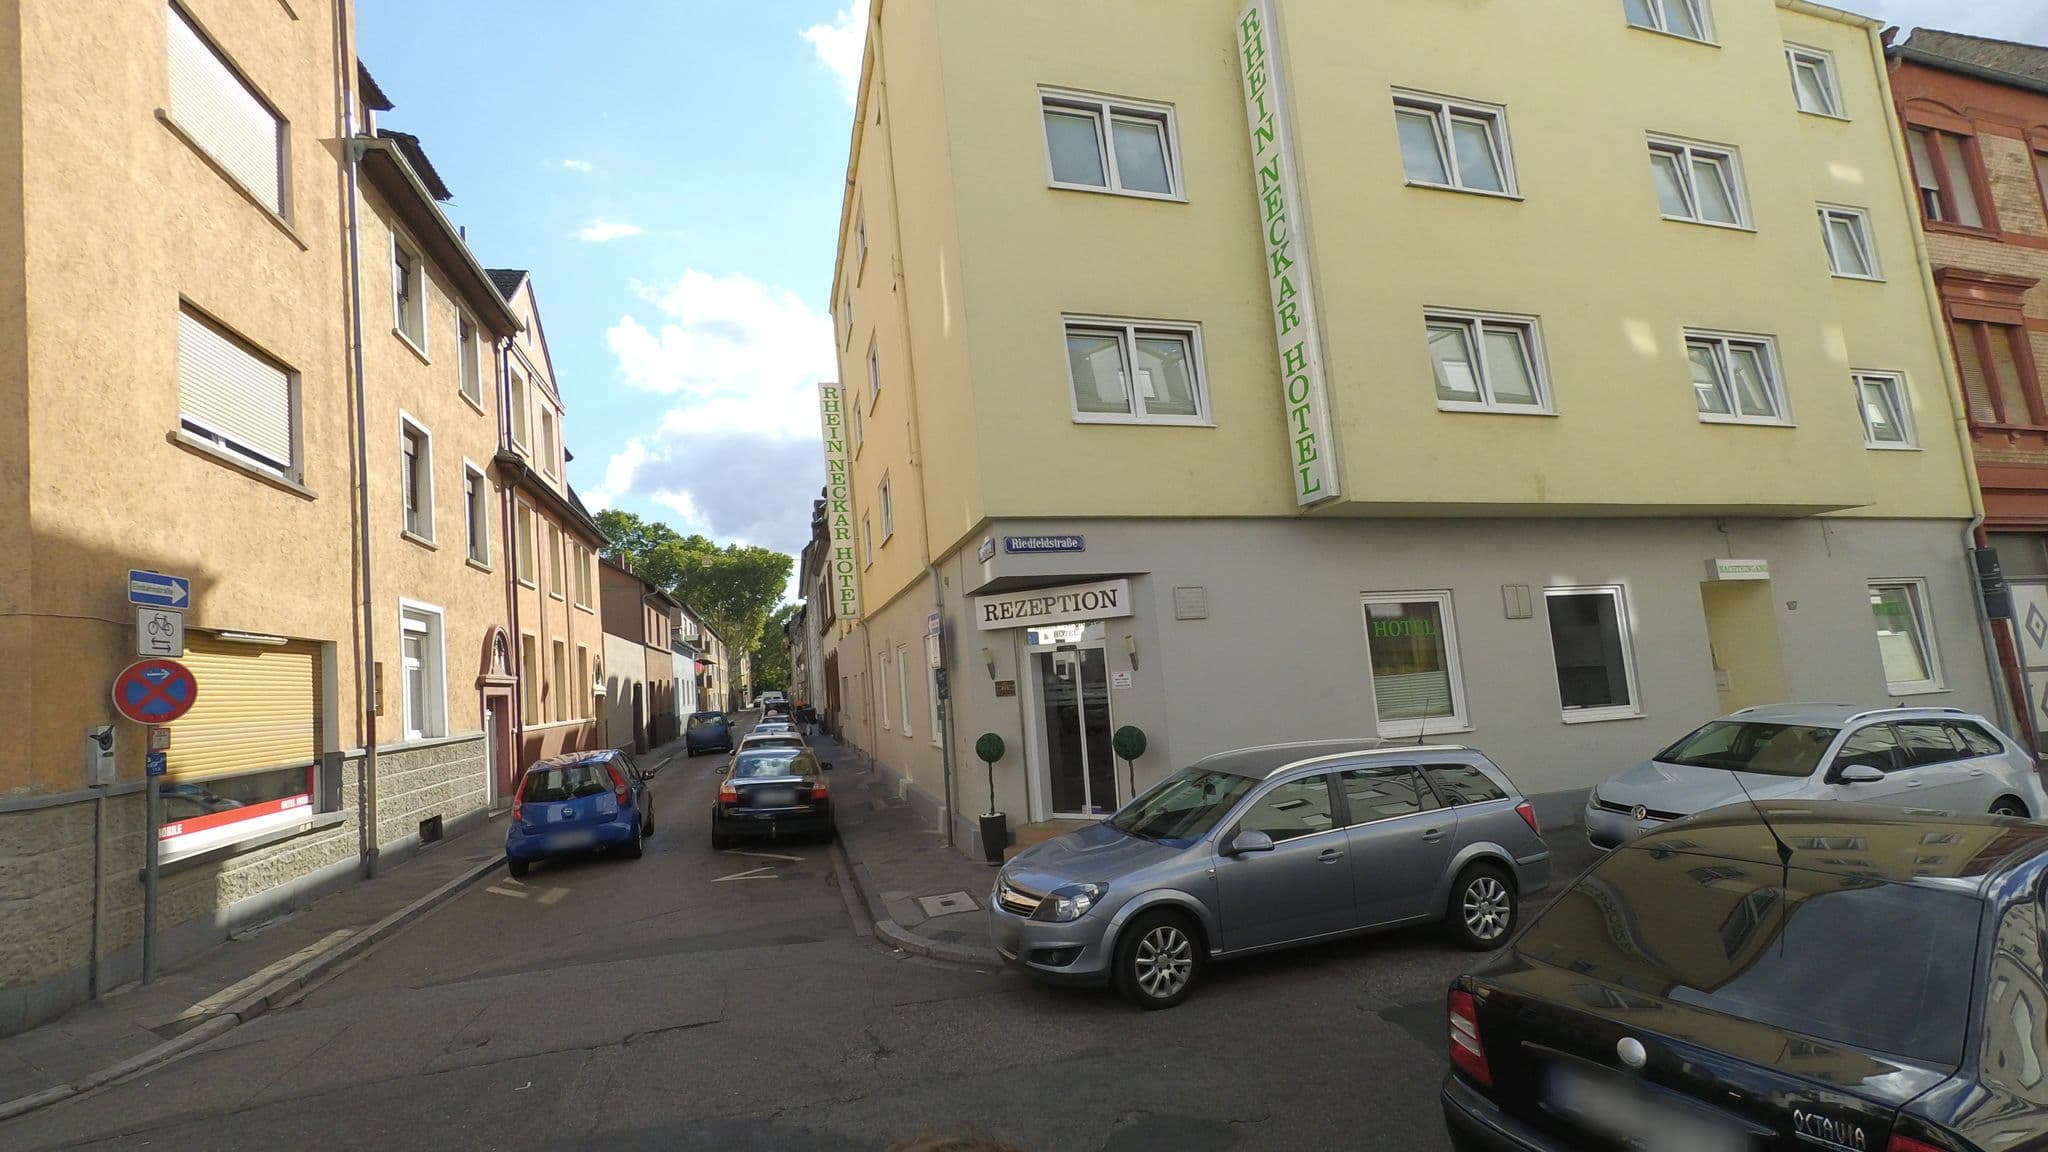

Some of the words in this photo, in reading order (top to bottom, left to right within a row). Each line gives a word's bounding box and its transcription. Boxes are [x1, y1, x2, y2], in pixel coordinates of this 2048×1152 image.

[1239, 6, 1276, 157] RHEIN
[1257, 154, 1302, 337] NECKAR
[823, 386, 843, 452] RHEIN
[1283, 342, 1321, 497] HOTEL
[828, 459, 851, 540] NECKAR
[1011, 537, 1078, 549] Riedfeldstraße
[835, 547, 856, 615] HOTEL
[984, 588, 1118, 622] REZEPTION
[1373, 619, 1435, 638] HOTEL
[1793, 1108, 1867, 1151] OCTAVIA
